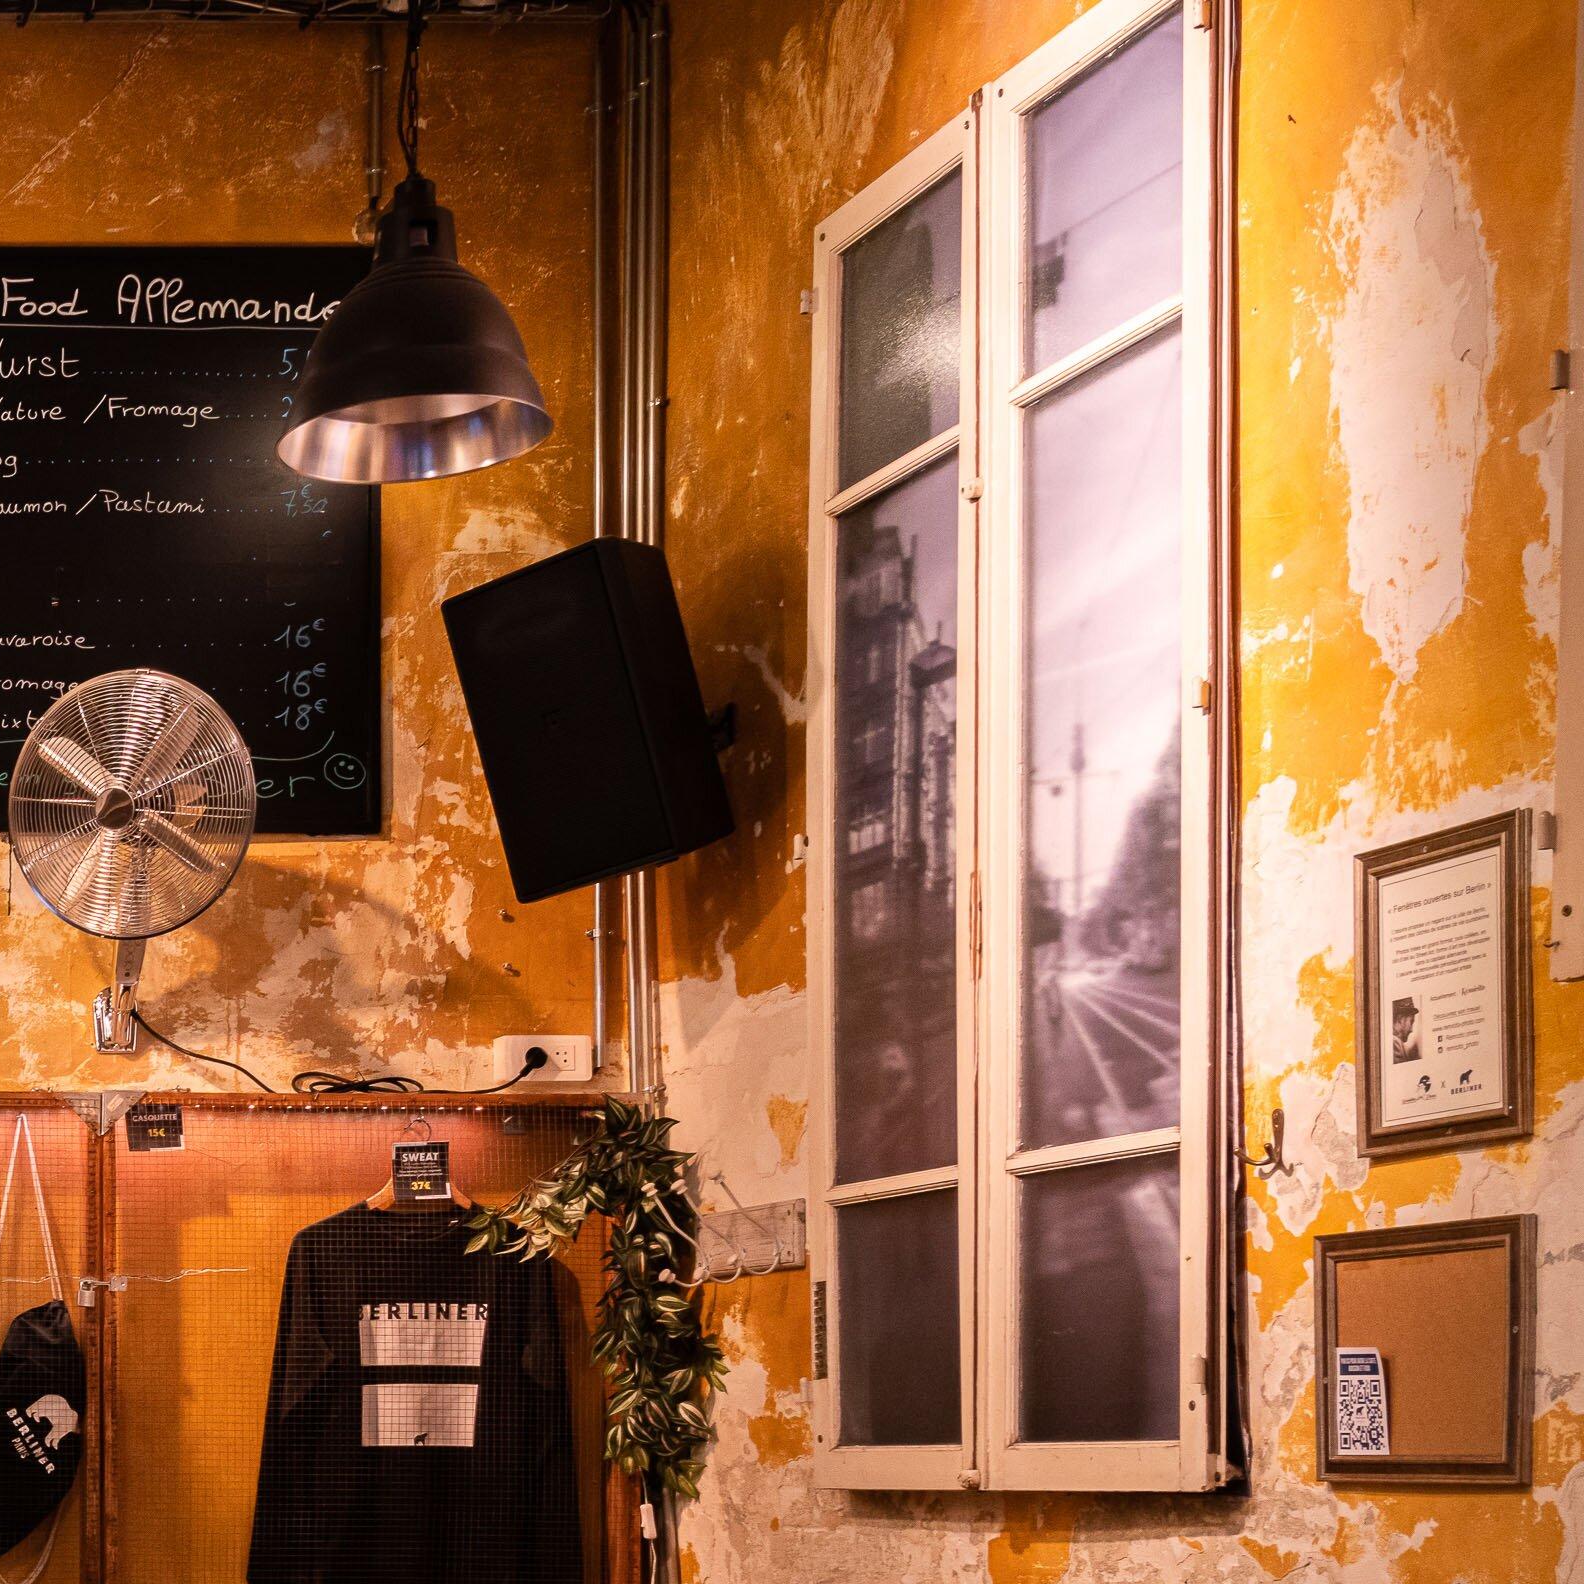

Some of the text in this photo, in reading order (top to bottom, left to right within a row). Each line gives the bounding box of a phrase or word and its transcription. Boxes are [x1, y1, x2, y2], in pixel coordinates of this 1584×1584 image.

[1, 277, 88, 319] Food
[1450, 1083, 1483, 1095] BERLINER
[402, 1152, 439, 1162] SWEAT
[411, 1181, 431, 1191] 37€
[6, 1408, 55, 1474] BERLINER
